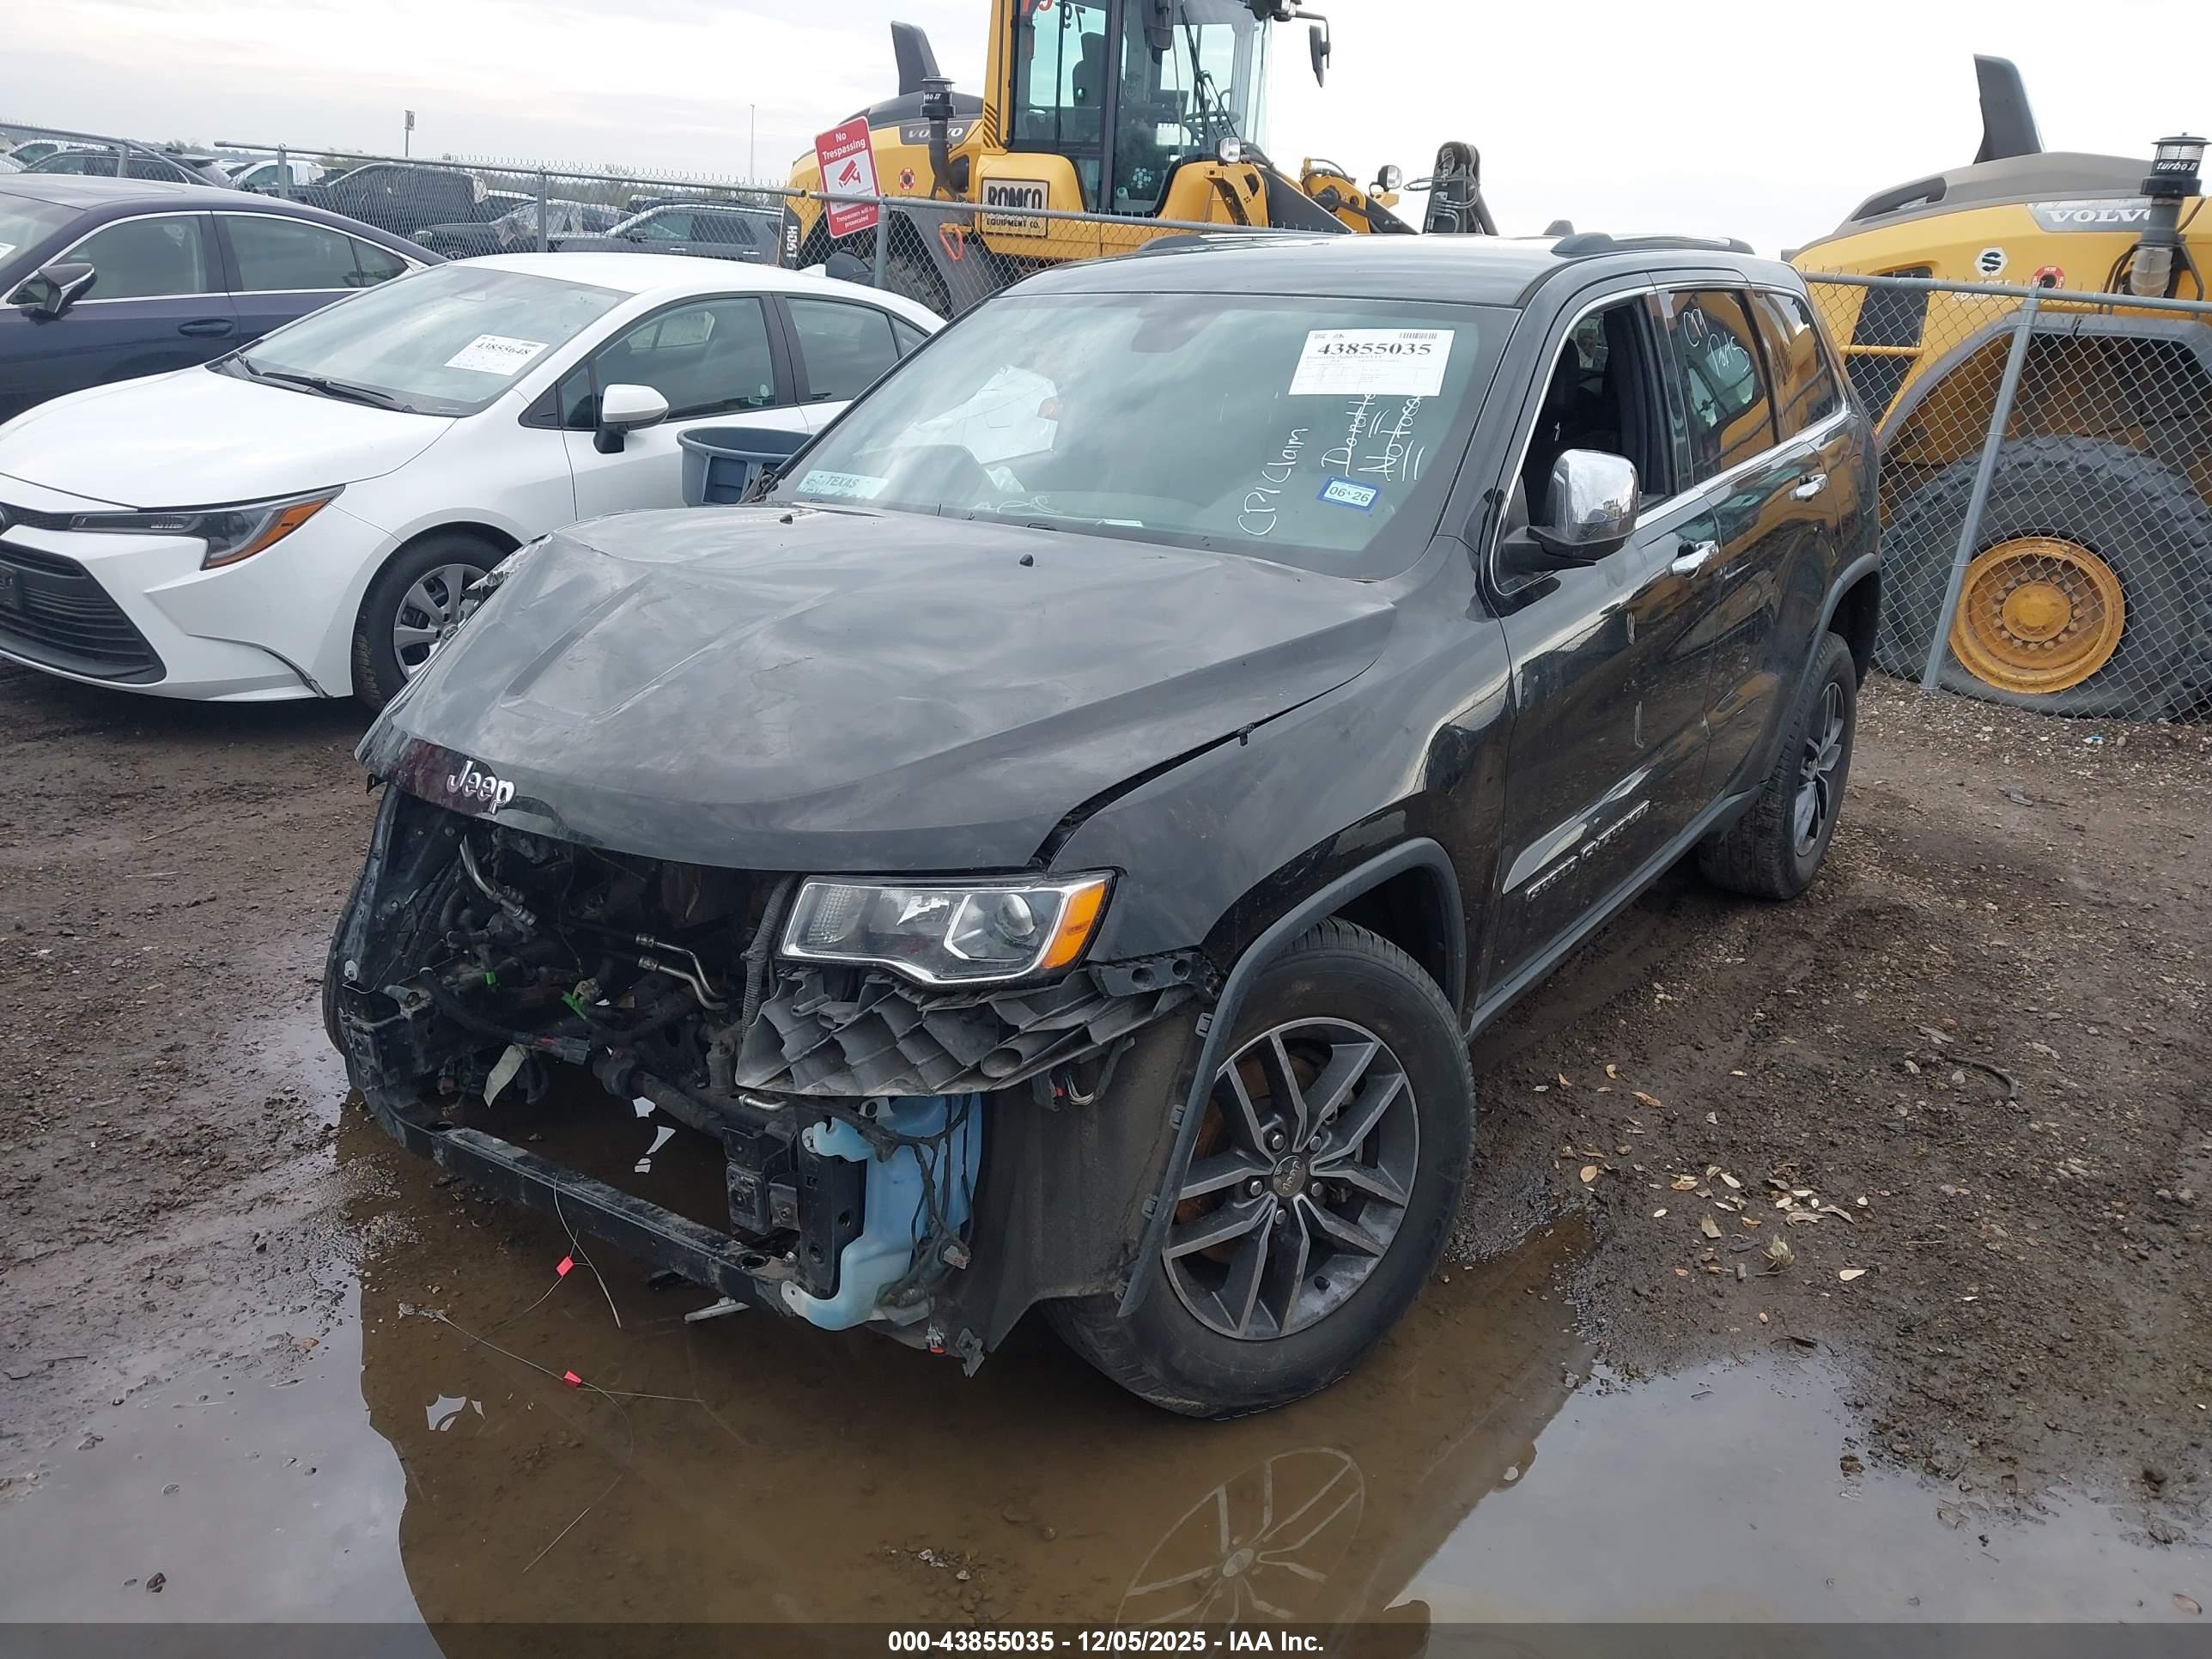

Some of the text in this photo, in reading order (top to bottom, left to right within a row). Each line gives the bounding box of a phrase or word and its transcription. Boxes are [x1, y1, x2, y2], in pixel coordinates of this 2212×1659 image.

[835, 131, 847, 143] No
[908, 127, 963, 138] VOVO
[822, 137, 866, 161] Trespassing
[2156, 161, 2188, 171] turbo
[476, 342, 532, 356] 43855648
[1316, 343, 1433, 356] 43855035
[824, 475, 860, 489] TEXAS
[1237, 428, 1310, 536] CPI Claim
[1328, 486, 1370, 502] 06 26
[447, 760, 515, 815] Jeep
